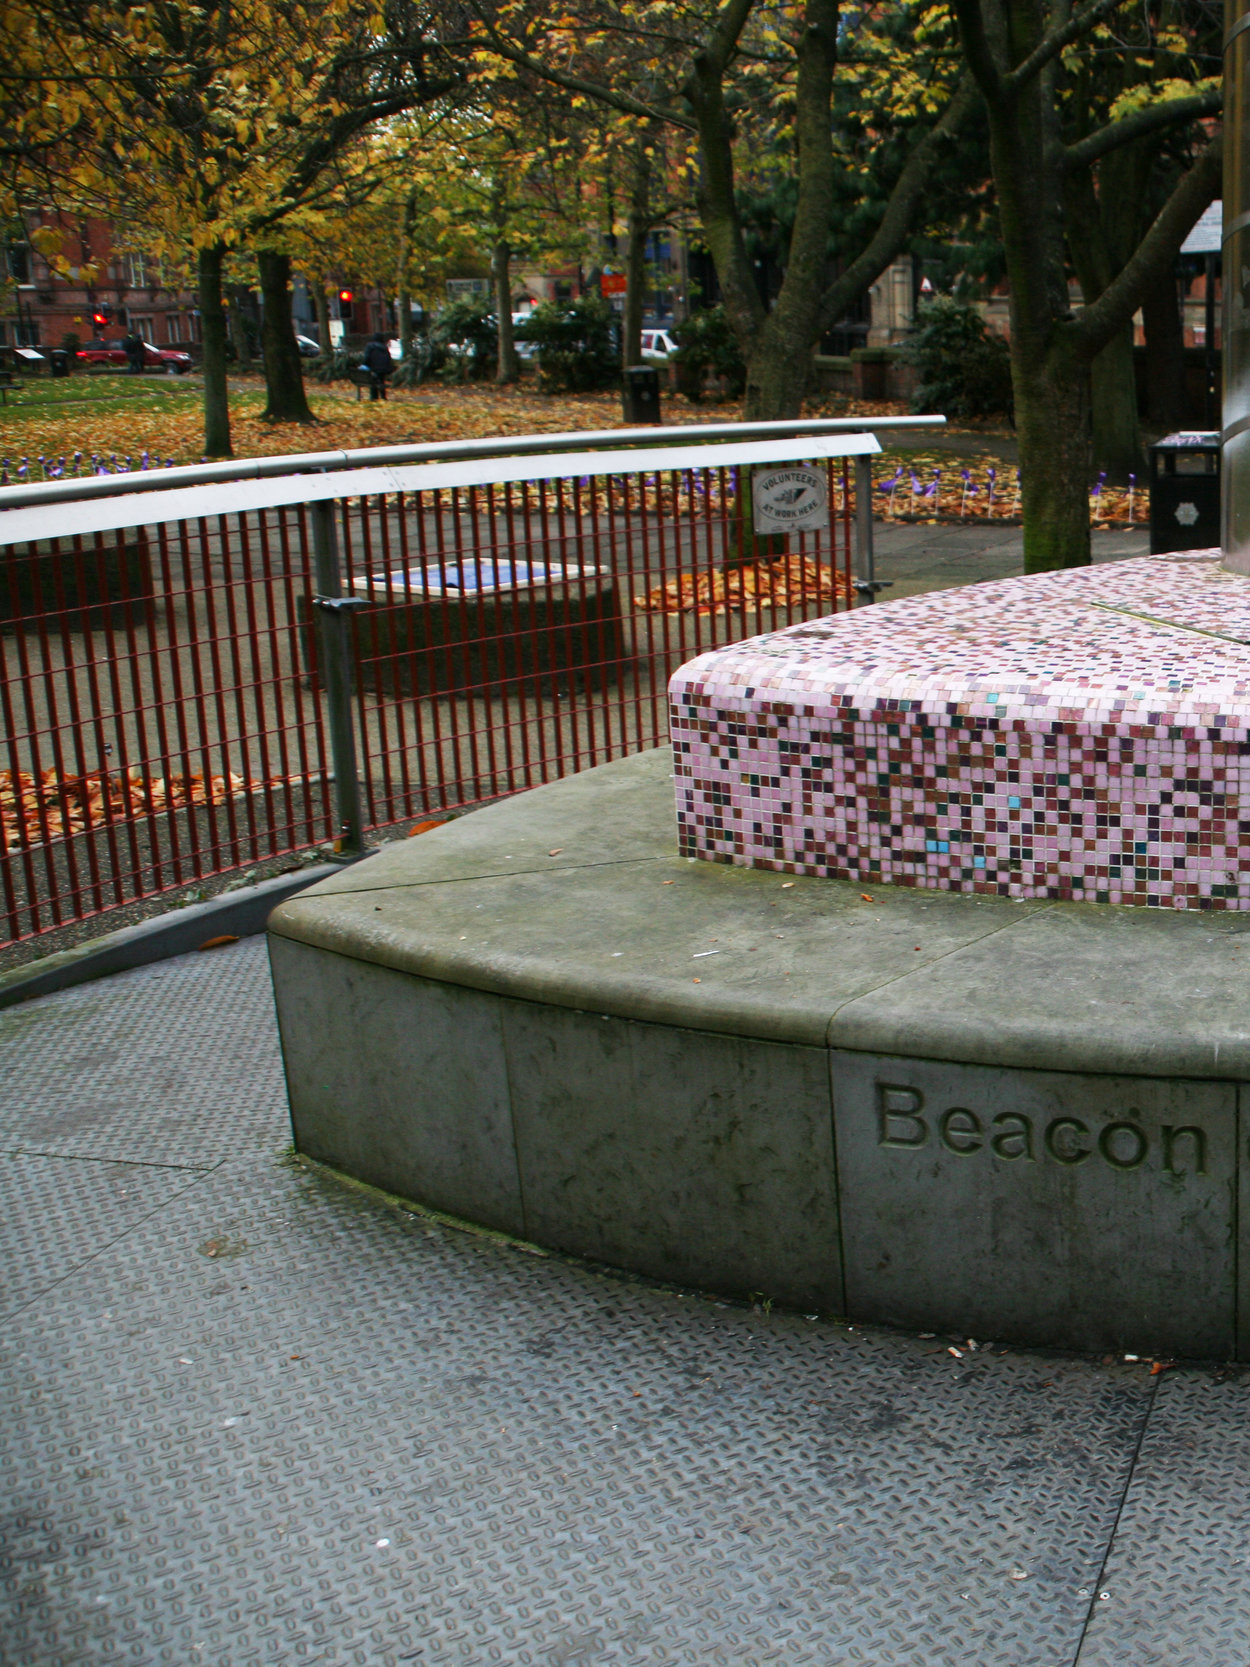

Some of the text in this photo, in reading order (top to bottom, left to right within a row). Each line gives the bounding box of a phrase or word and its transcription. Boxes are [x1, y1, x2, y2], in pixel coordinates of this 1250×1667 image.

[762, 472, 817, 490] VOLUNTEERS
[762, 500, 818, 519] AT WORK HERE
[875, 1080, 1208, 1176] Beacon
